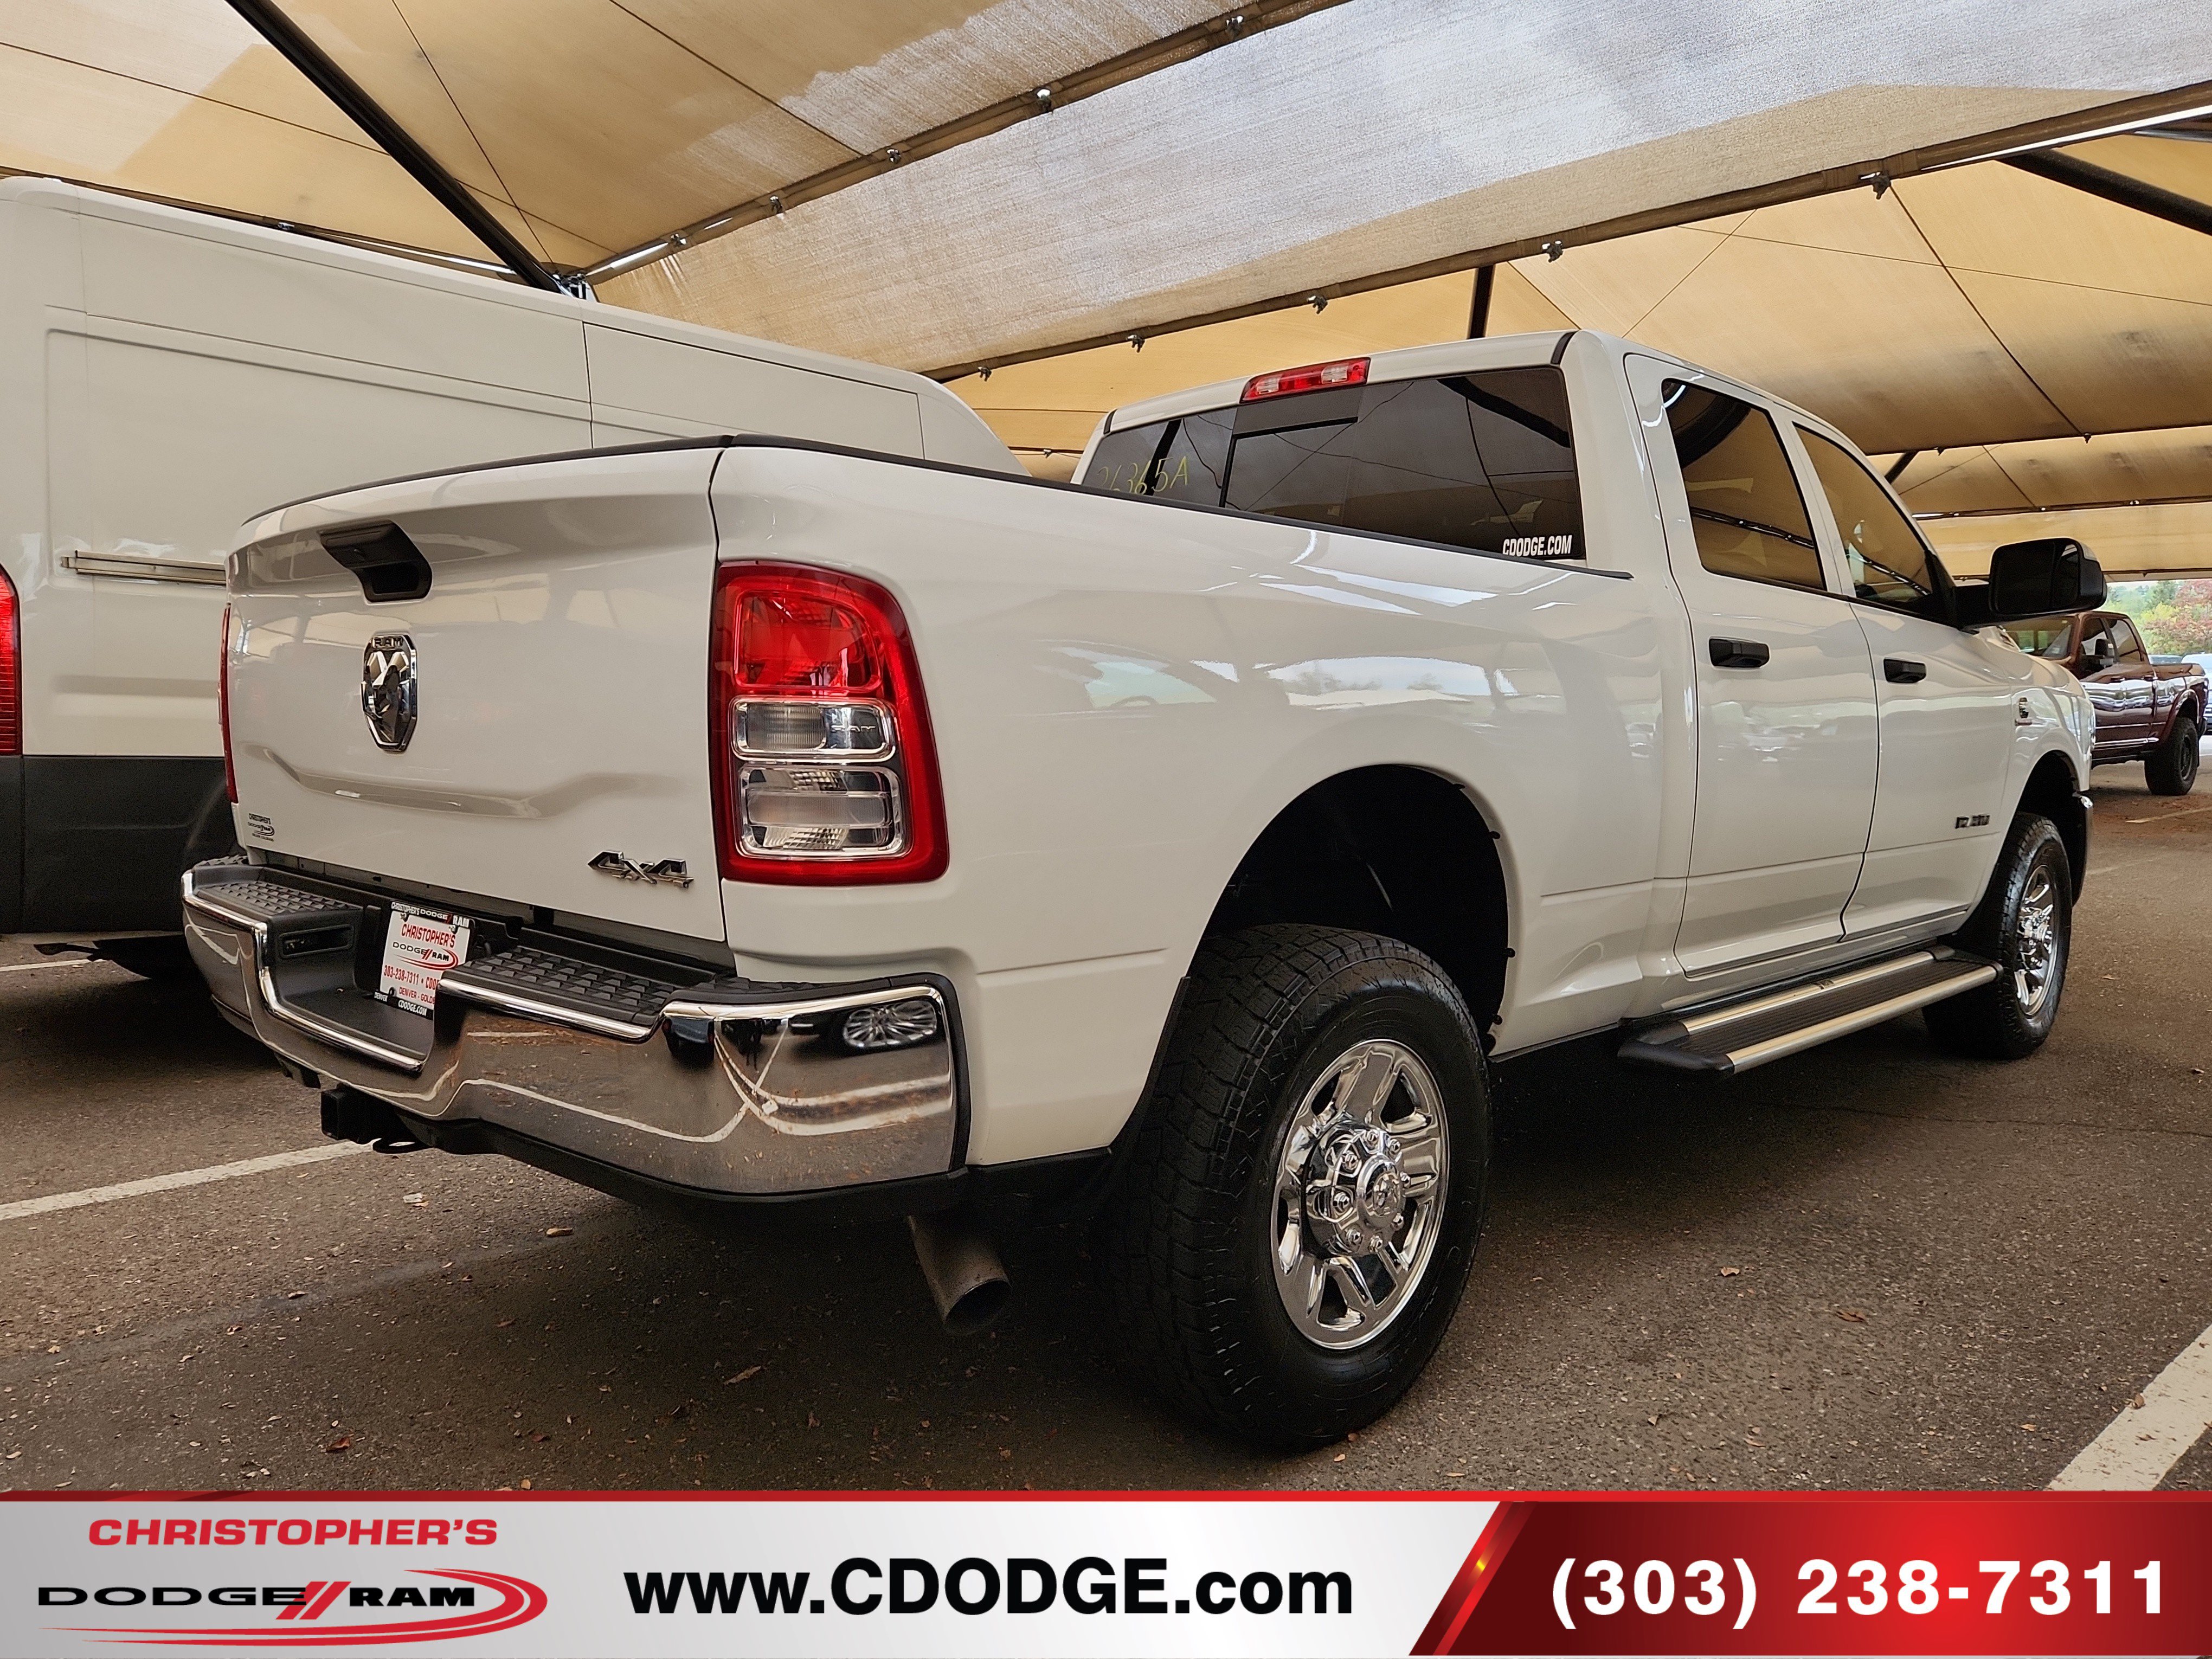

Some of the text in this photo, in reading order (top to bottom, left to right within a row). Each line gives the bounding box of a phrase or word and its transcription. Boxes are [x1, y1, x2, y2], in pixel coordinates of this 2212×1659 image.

[1502, 535, 1572, 557] CDODGE.COM
[372, 636, 403, 648] RAM
[420, 909, 448, 920] DODGE
[452, 915, 470, 928] RAM
[401, 923, 455, 948] CHRISTOPHER'S
[393, 942, 449, 961] DODGE RAM
[383, 964, 419, 985] 303-238-7311
[399, 986, 417, 999] DENVER
[398, 1000, 427, 1016] CDODGE.COM
